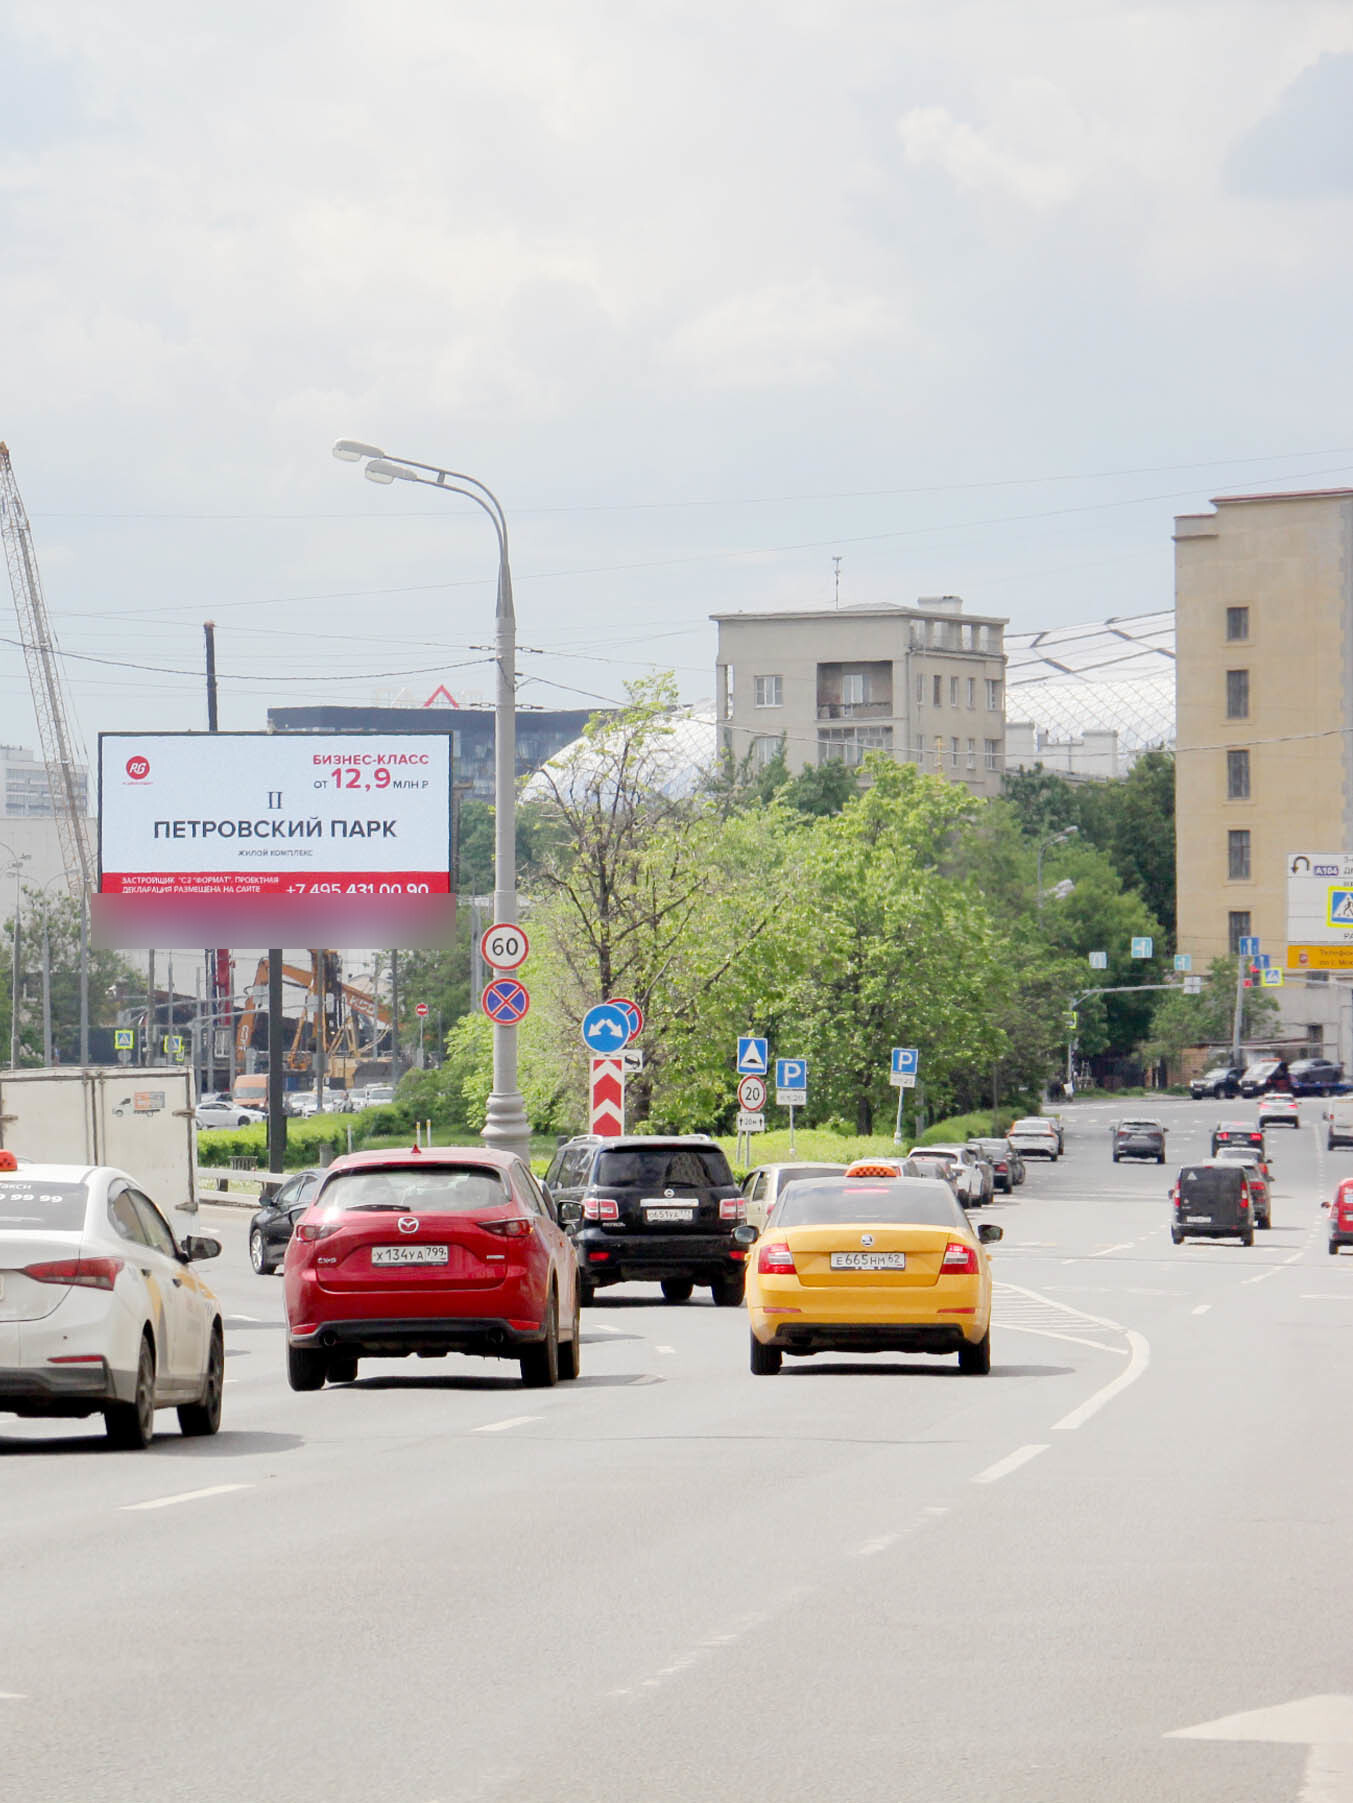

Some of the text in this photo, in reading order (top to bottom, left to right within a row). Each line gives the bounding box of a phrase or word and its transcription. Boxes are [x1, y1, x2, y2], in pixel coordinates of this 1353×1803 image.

[313, 753, 430, 765] БИЗНЕС-КЛАСС
[331, 767, 391, 792] 12,9
[393, 779, 419, 789] МЛН
[153, 816, 398, 839] ПЕТРОВСКИЙ ПАРК
[121, 876, 175, 885] ЗАСТРОЙЩИК
[234, 876, 279, 884] ПРОЕКТНАЯ
[173, 885, 222, 893] РАЗМЕЩЕНА
[224, 885, 235, 893] НА
[236, 885, 261, 893] САЙТЕ
[492, 937, 519, 956] 60
[745, 1086, 760, 1097] 20
[10, 1193, 35, 1202] 99
[39, 1194, 64, 1203] 99
